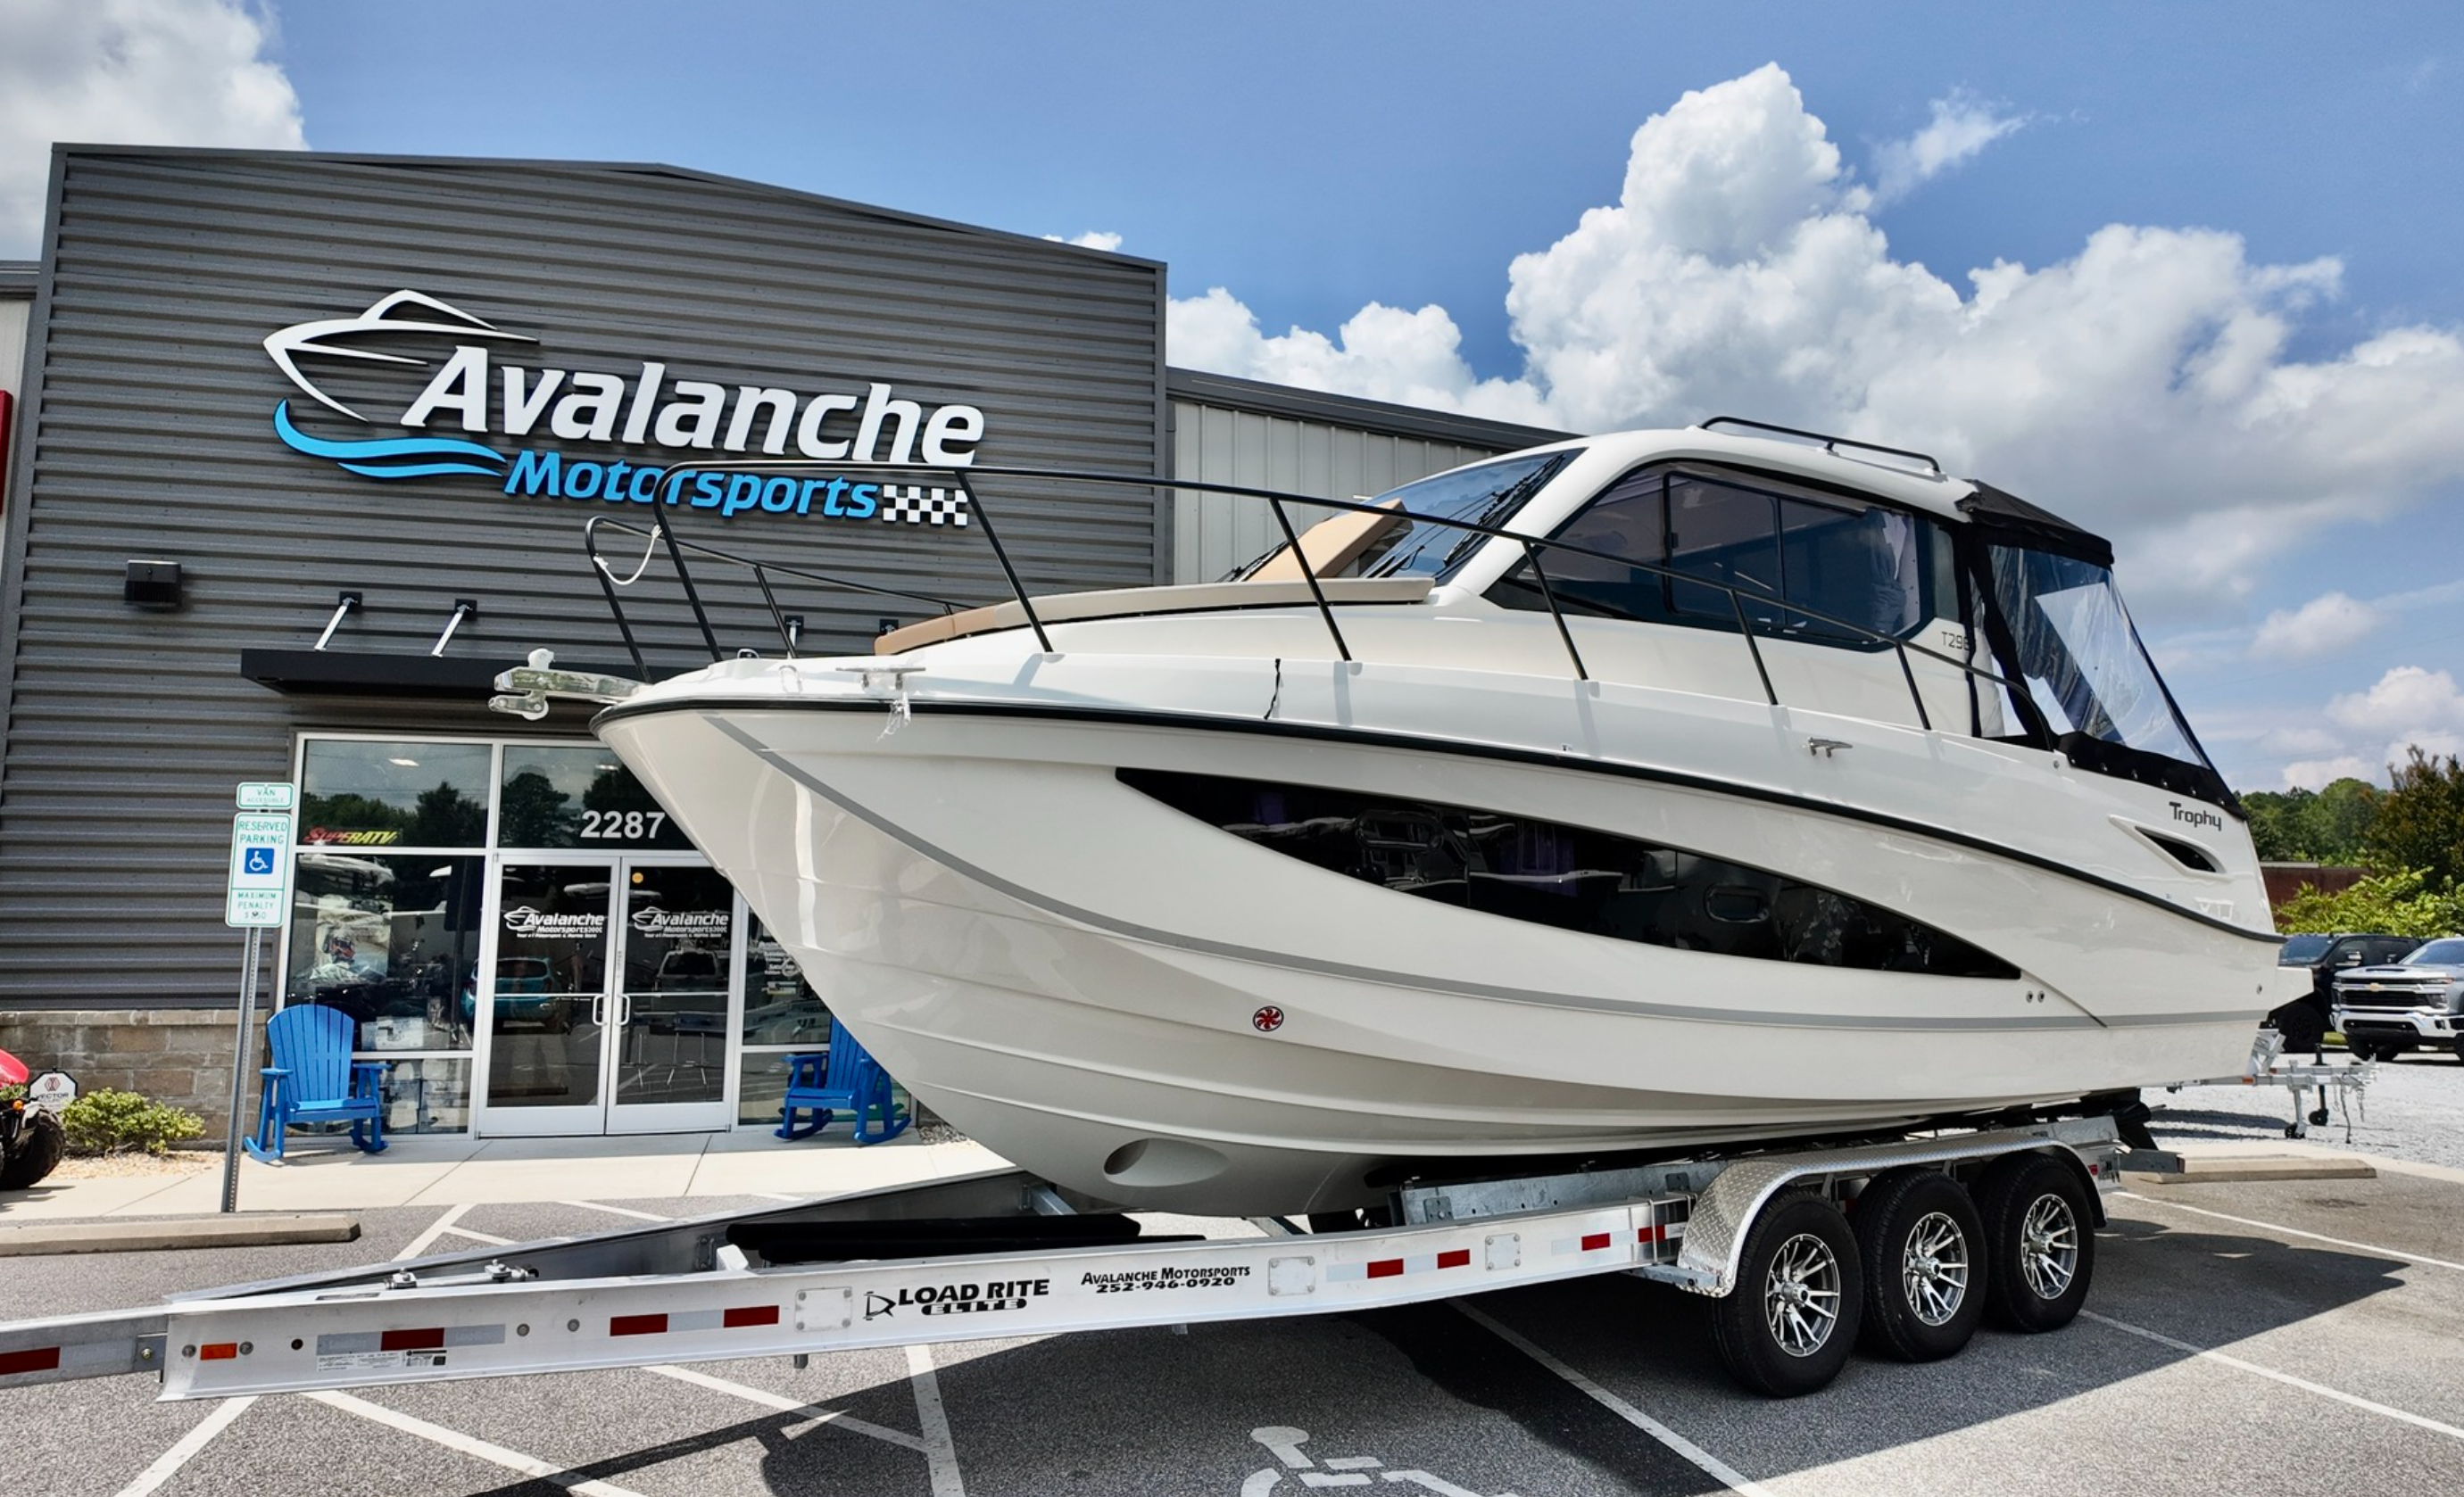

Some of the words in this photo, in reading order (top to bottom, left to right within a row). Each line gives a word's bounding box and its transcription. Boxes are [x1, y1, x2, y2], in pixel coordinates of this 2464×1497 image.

[400, 344, 985, 467] Avalanche
[503, 449, 879, 517] Motorsports
[257, 788, 277, 797] VAN
[2169, 801, 2222, 831] Trophy
[237, 821, 288, 831] RESERVED
[580, 810, 666, 839] 2287
[239, 834, 285, 845] PARKING
[237, 901, 274, 909] PENALTY
[523, 912, 605, 926] Avalanche
[651, 912, 729, 926] Avalanche
[536, 926, 589, 934] Motorsports
[663, 925, 714, 934] Motorsports
[1081, 1270, 1158, 1286] AVALANCHE
[1160, 1266, 1250, 1280] MOTORSPORTS
[898, 1284, 980, 1306] LOAD
[986, 1278, 1050, 1299] RITE
[1096, 1277, 1235, 1294] 252-946-0920
[931, 1298, 1019, 1316] ELITE
